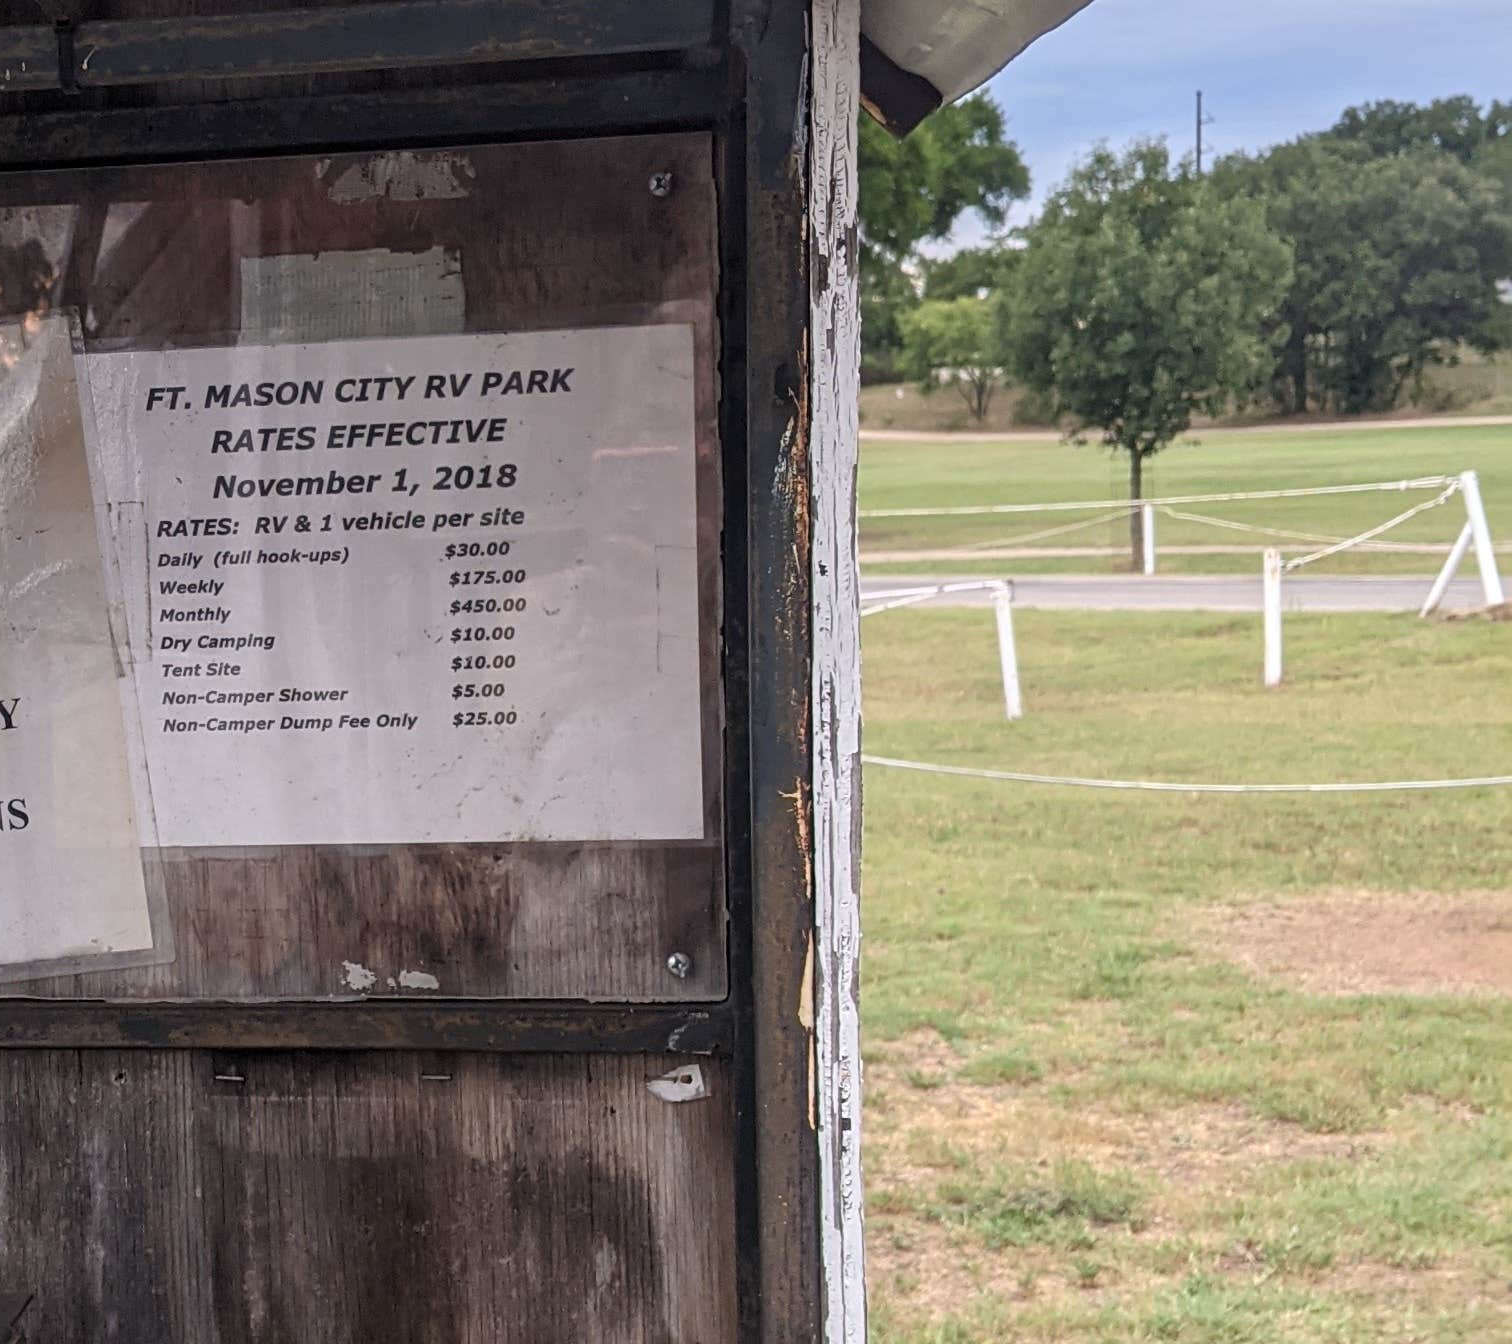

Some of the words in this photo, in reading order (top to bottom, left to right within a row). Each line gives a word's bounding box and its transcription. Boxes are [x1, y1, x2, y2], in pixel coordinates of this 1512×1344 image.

[146, 387, 191, 411] FT.
[204, 380, 324, 409] MASON
[335, 376, 416, 402] CITY
[424, 373, 472, 399] RV
[480, 368, 575, 396] PARK
[211, 427, 317, 453] RATES
[327, 418, 507, 448] EFFECTIVE
[213, 471, 381, 498] November
[392, 468, 420, 496] 1,
[433, 464, 518, 490] 2018
[157, 518, 239, 537] RATES:
[255, 516, 288, 534] RV
[294, 515, 311, 533] &
[320, 514, 332, 531] 1
[342, 511, 425, 530] vehicle
[432, 512, 474, 532] per
[480, 508, 525, 526] site
[157, 553, 203, 569] Daily
[213, 550, 251, 568] (full
[257, 547, 349, 565] hook-ups)
[445, 542, 510, 560] $30.00
[159, 580, 224, 596] Weekly
[449, 570, 526, 588] $175.00
[159, 607, 231, 623] Monthly
[450, 598, 526, 616] $450.00
[161, 636, 192, 652] Dry
[197, 634, 275, 650] Camping
[450, 627, 515, 644] $10.00
[162, 663, 201, 678] Tent
[206, 662, 241, 676] Site
[451, 655, 516, 672] $10.00
[162, 690, 274, 706] Non-Camper
[278, 688, 348, 703] Shower
[451, 684, 505, 700] $5.00
[163, 717, 275, 734] Non-Camper
[280, 716, 333, 731] Dump
[339, 715, 371, 728] Fee
[376, 713, 418, 730] Only
[453, 711, 517, 728] $25.00
